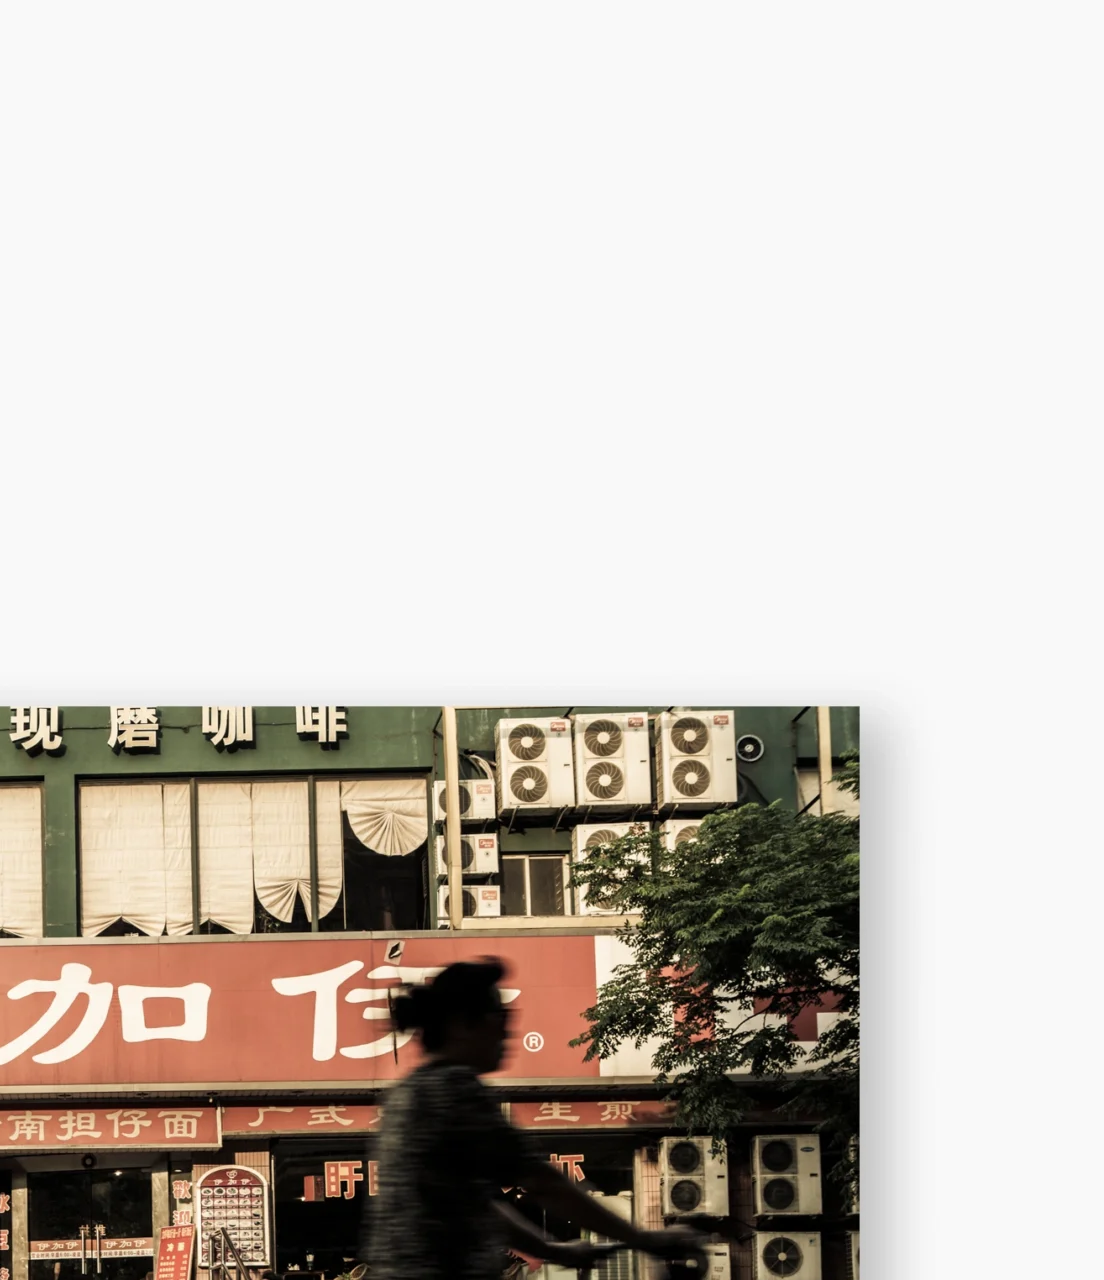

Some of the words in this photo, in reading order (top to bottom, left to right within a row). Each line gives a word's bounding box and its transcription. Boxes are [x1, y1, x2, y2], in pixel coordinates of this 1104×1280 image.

[9, 706, 347, 750] 现磨咖啡
[248, 1104, 384, 1128] 广式
[533, 1101, 678, 1122] 生煎
[37, 1241, 79, 1251] 伊加伊
[104, 1239, 147, 1249] 伊加伊
